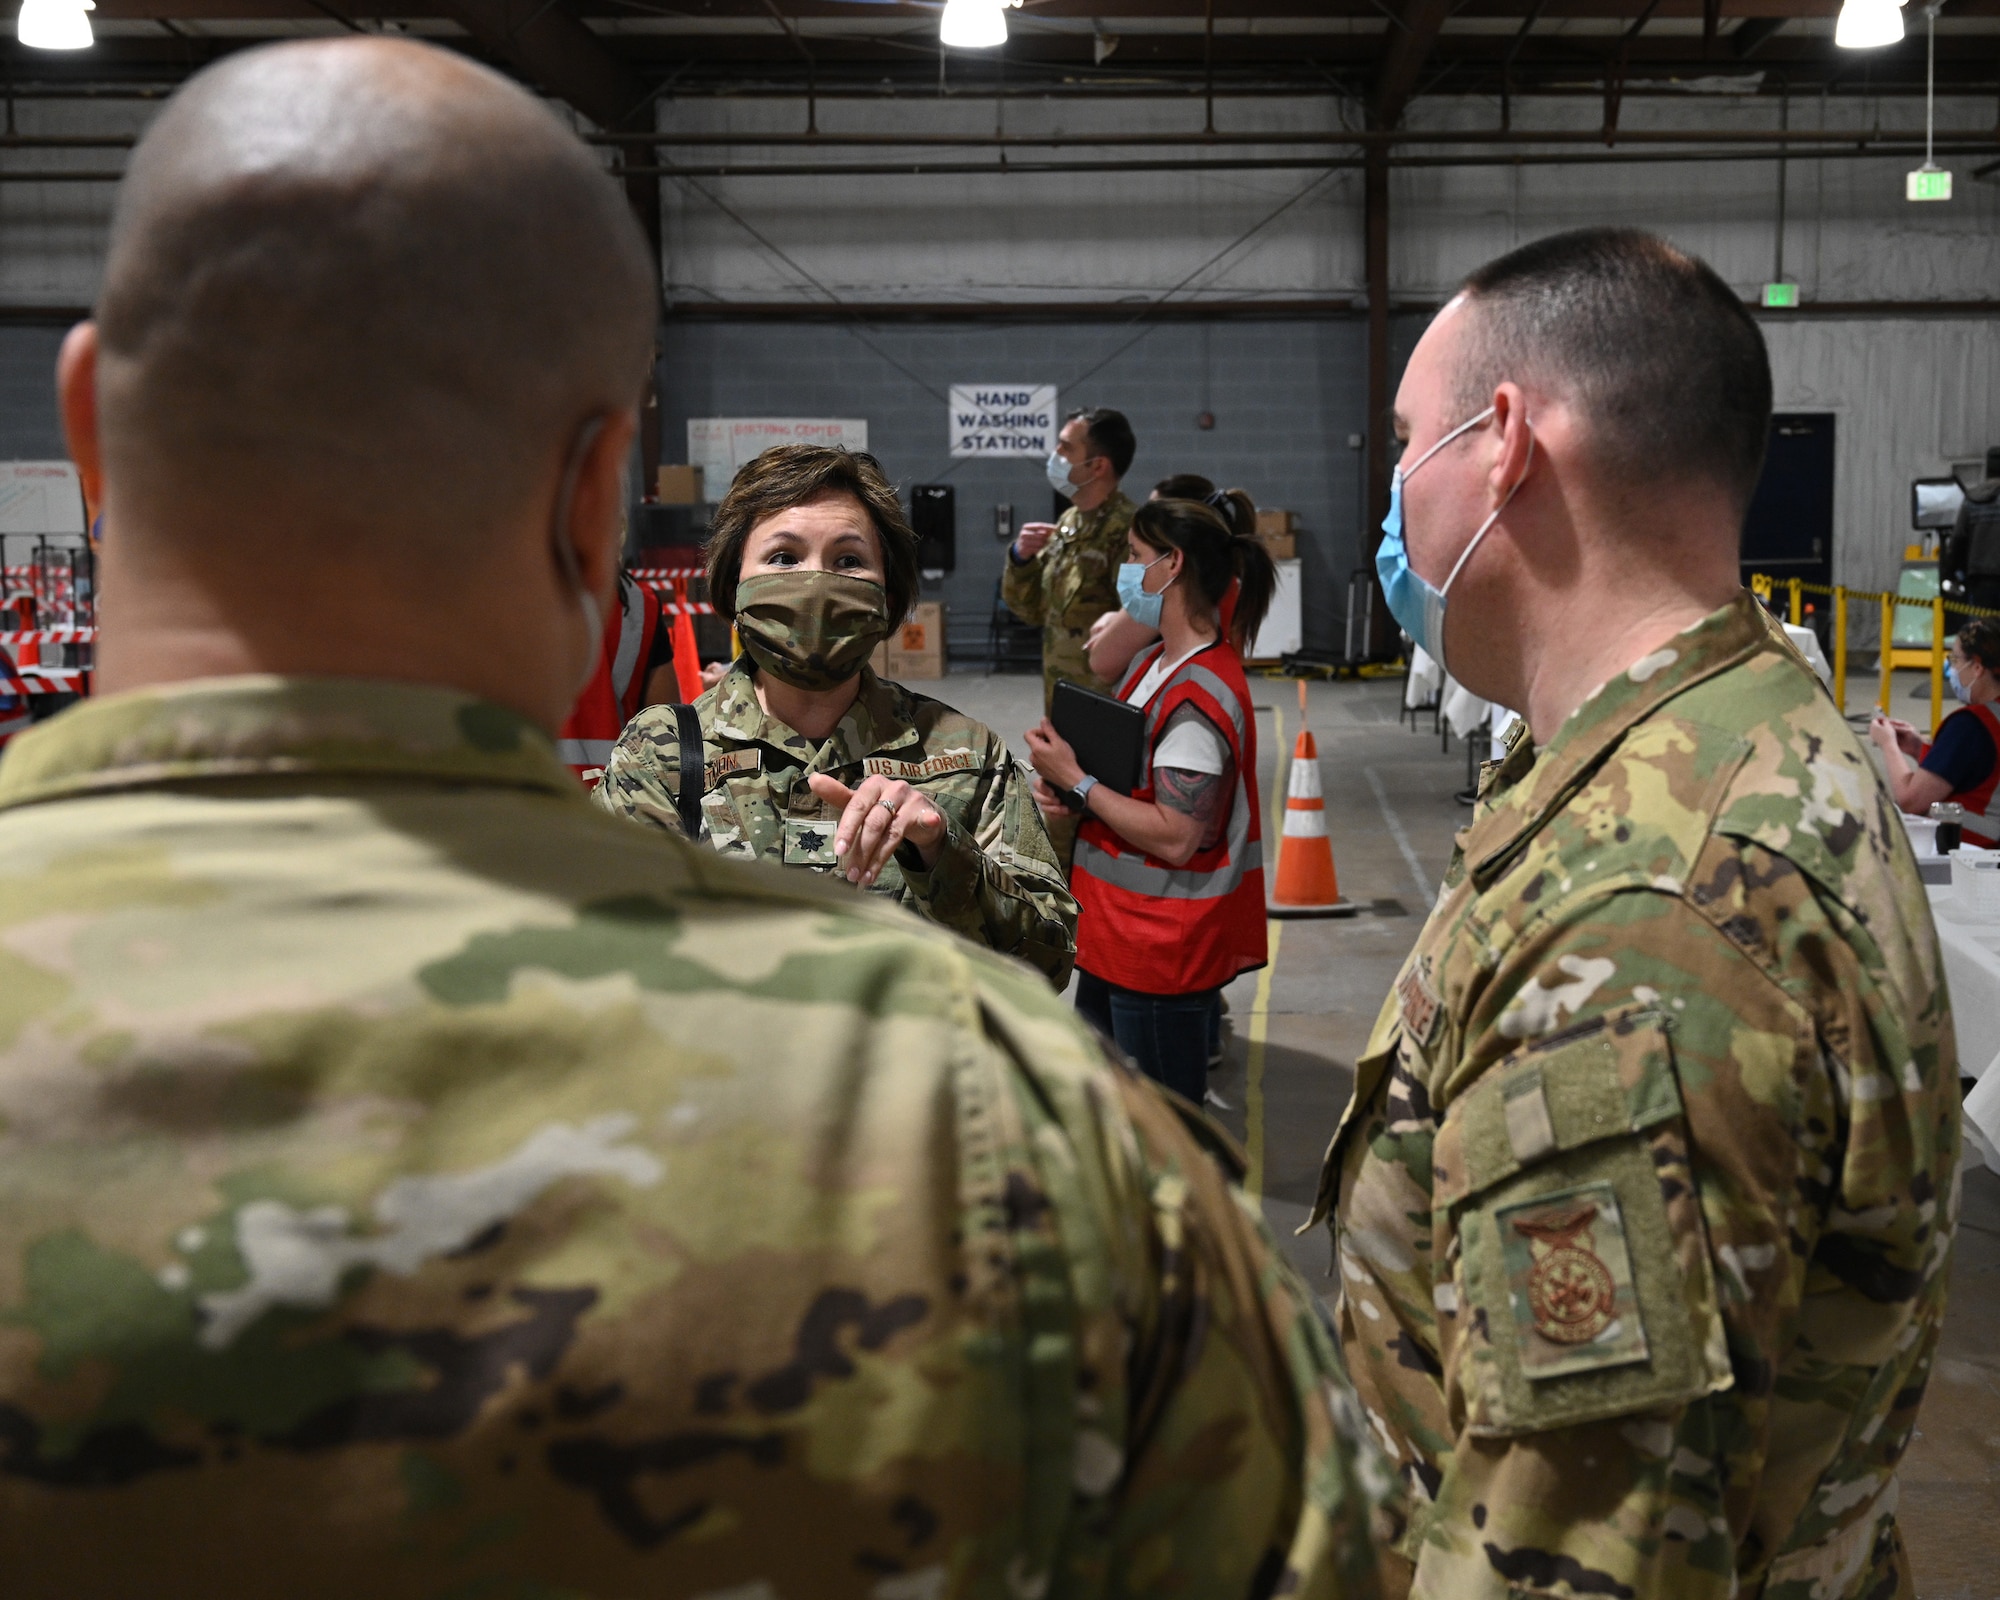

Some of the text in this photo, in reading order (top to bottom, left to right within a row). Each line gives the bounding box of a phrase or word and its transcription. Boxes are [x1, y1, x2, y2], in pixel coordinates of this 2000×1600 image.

[976, 392, 1031, 406] HAND
[957, 414, 1049, 428] WASHING
[962, 436, 1045, 450] STATION
[868, 753, 974, 778] U.S. AIR FORCE
